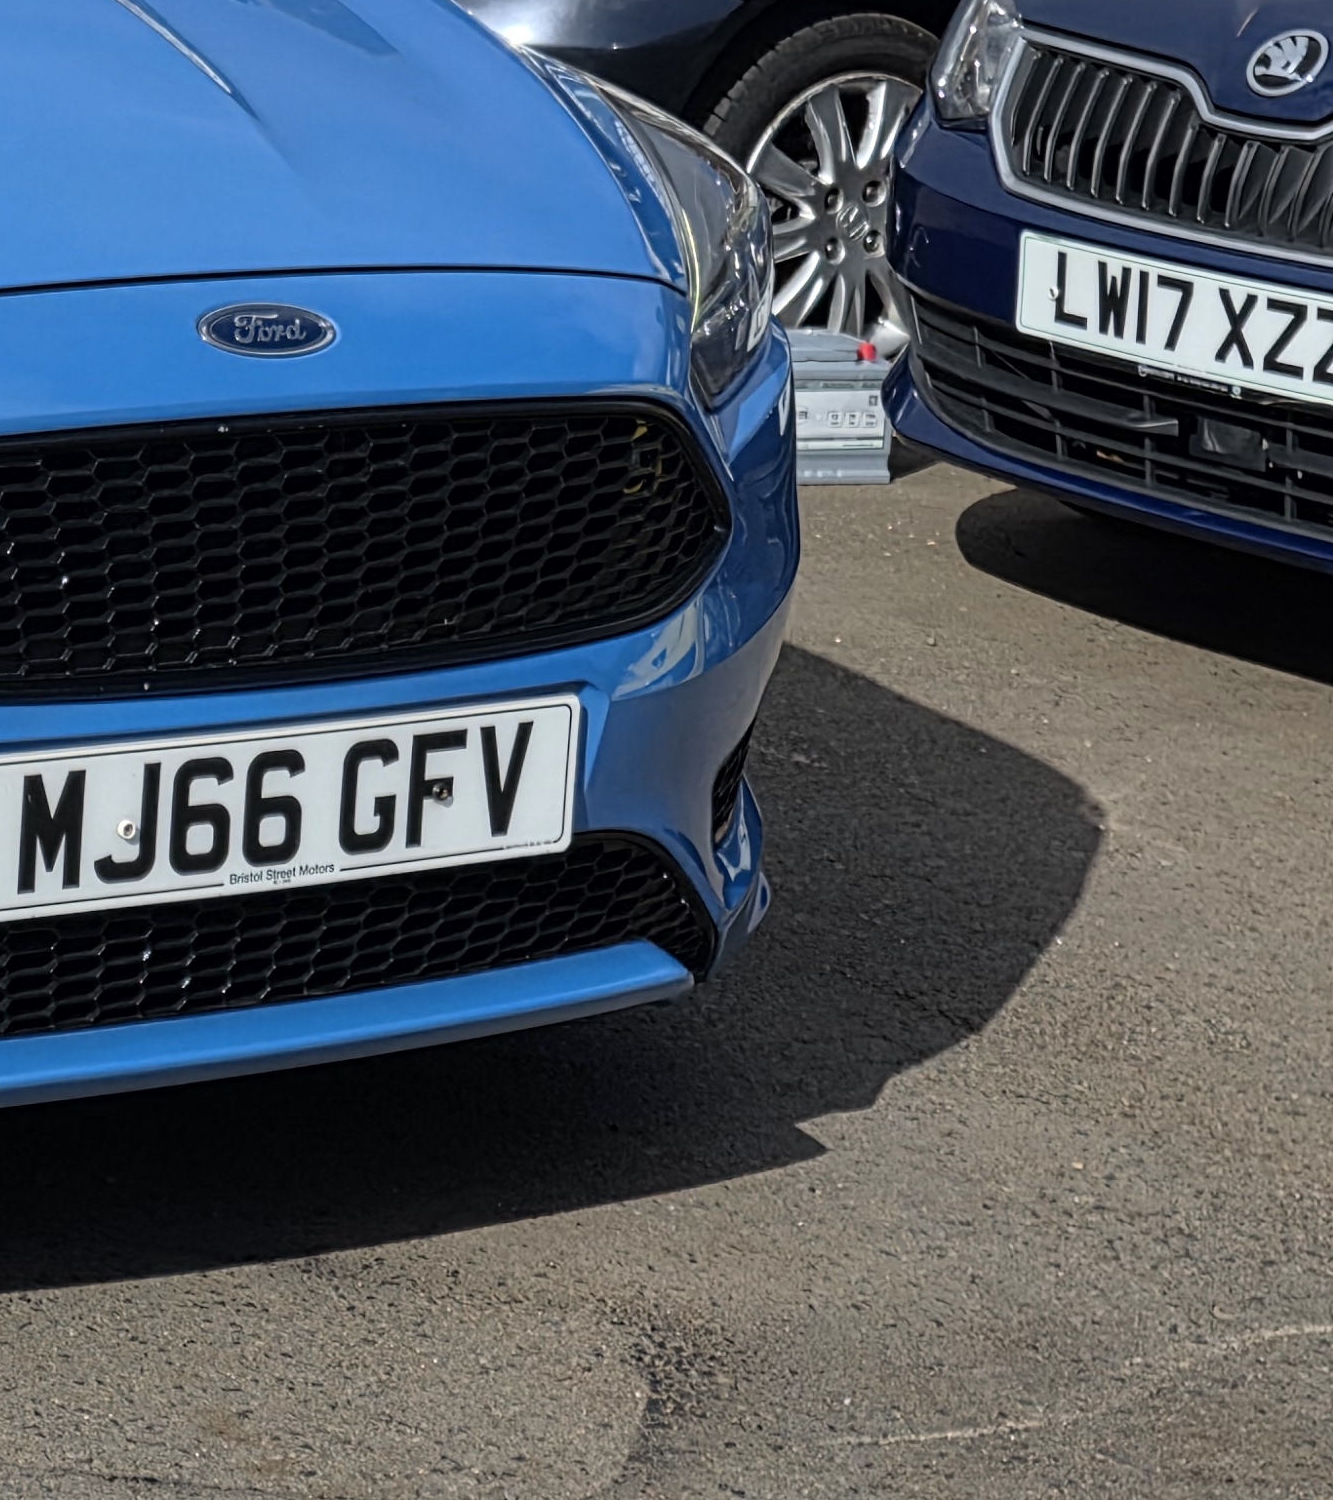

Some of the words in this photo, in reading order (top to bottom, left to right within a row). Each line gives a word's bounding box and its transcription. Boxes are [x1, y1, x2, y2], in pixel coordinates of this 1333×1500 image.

[234, 314, 307, 343] Ford
[1054, 251, 1194, 352] LW17
[16, 748, 306, 895] MJ66
[338, 721, 534, 856] GFV
[229, 870, 263, 885] Bristol
[266, 867, 296, 880] Street
[299, 864, 335, 877] Motors
